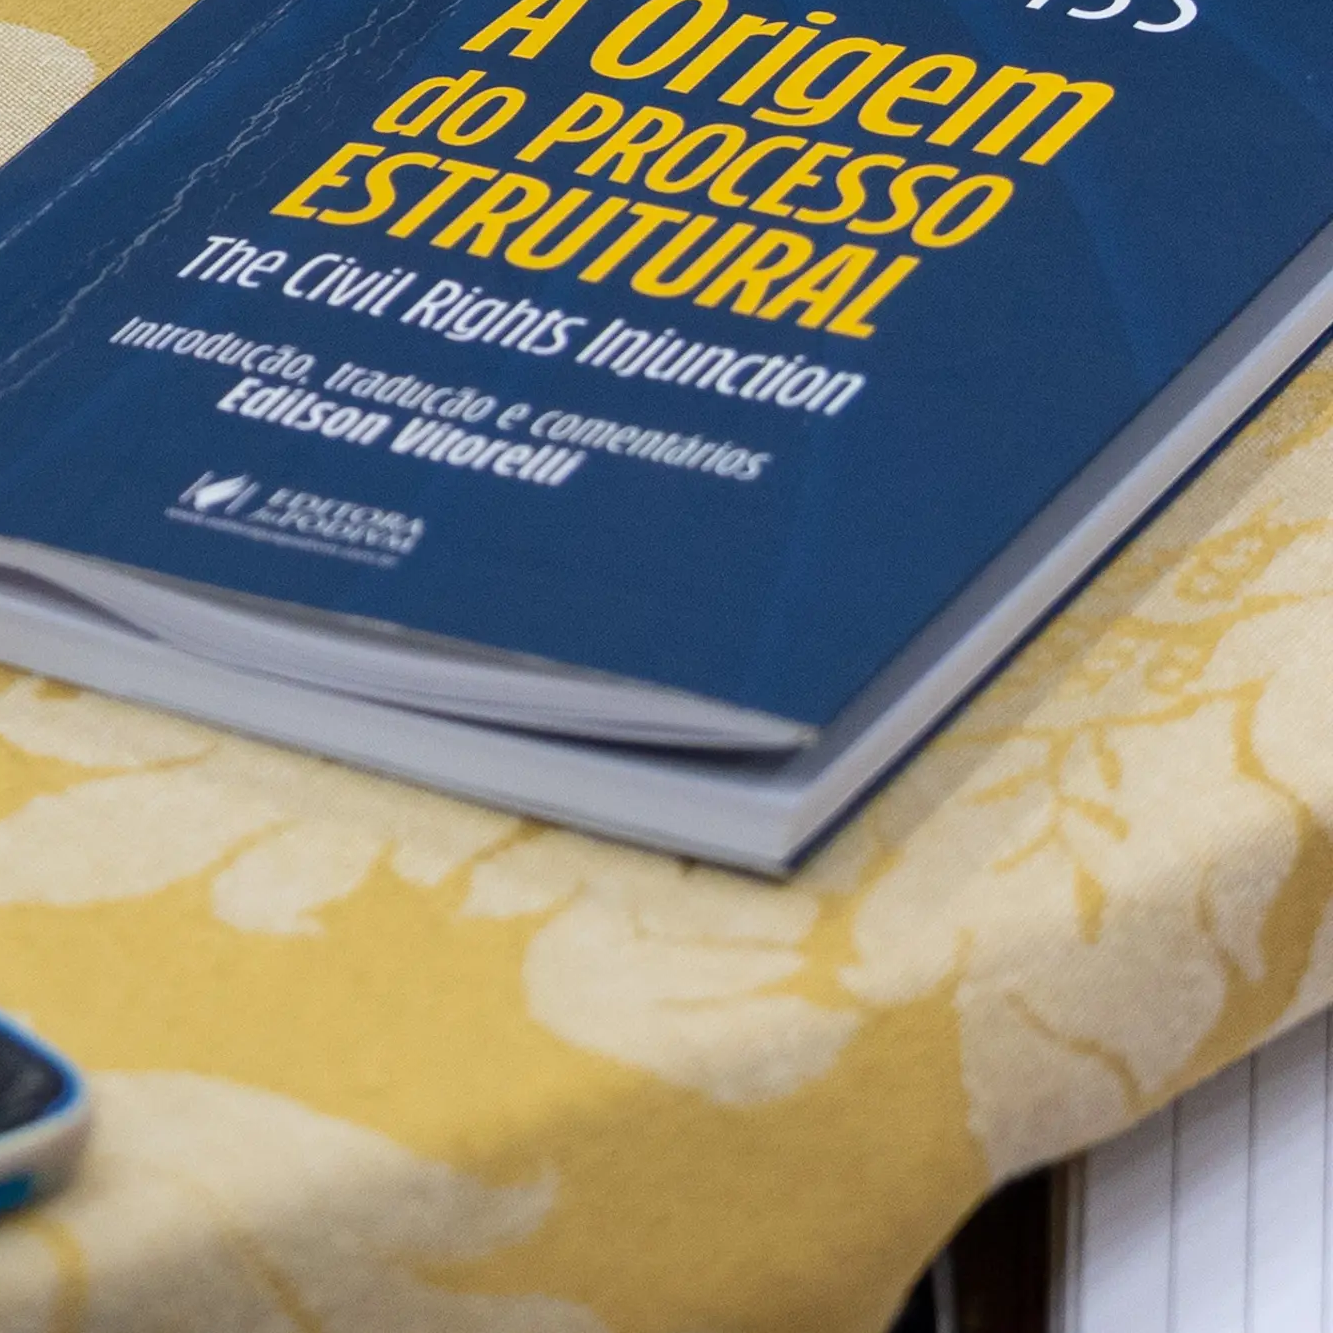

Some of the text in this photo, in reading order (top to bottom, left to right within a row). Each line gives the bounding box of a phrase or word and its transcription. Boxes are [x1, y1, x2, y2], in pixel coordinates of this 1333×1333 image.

[270, 142, 921, 339] ESTRUTURAL
[372, 68, 1014, 248] do PROCESSO
[176, 233, 866, 417] The Civil Rights Injunction
[215, 375, 588, 487] Edilson Vitorelli
[495, 403, 532, 431] e
[529, 410, 771, 482] comentários
